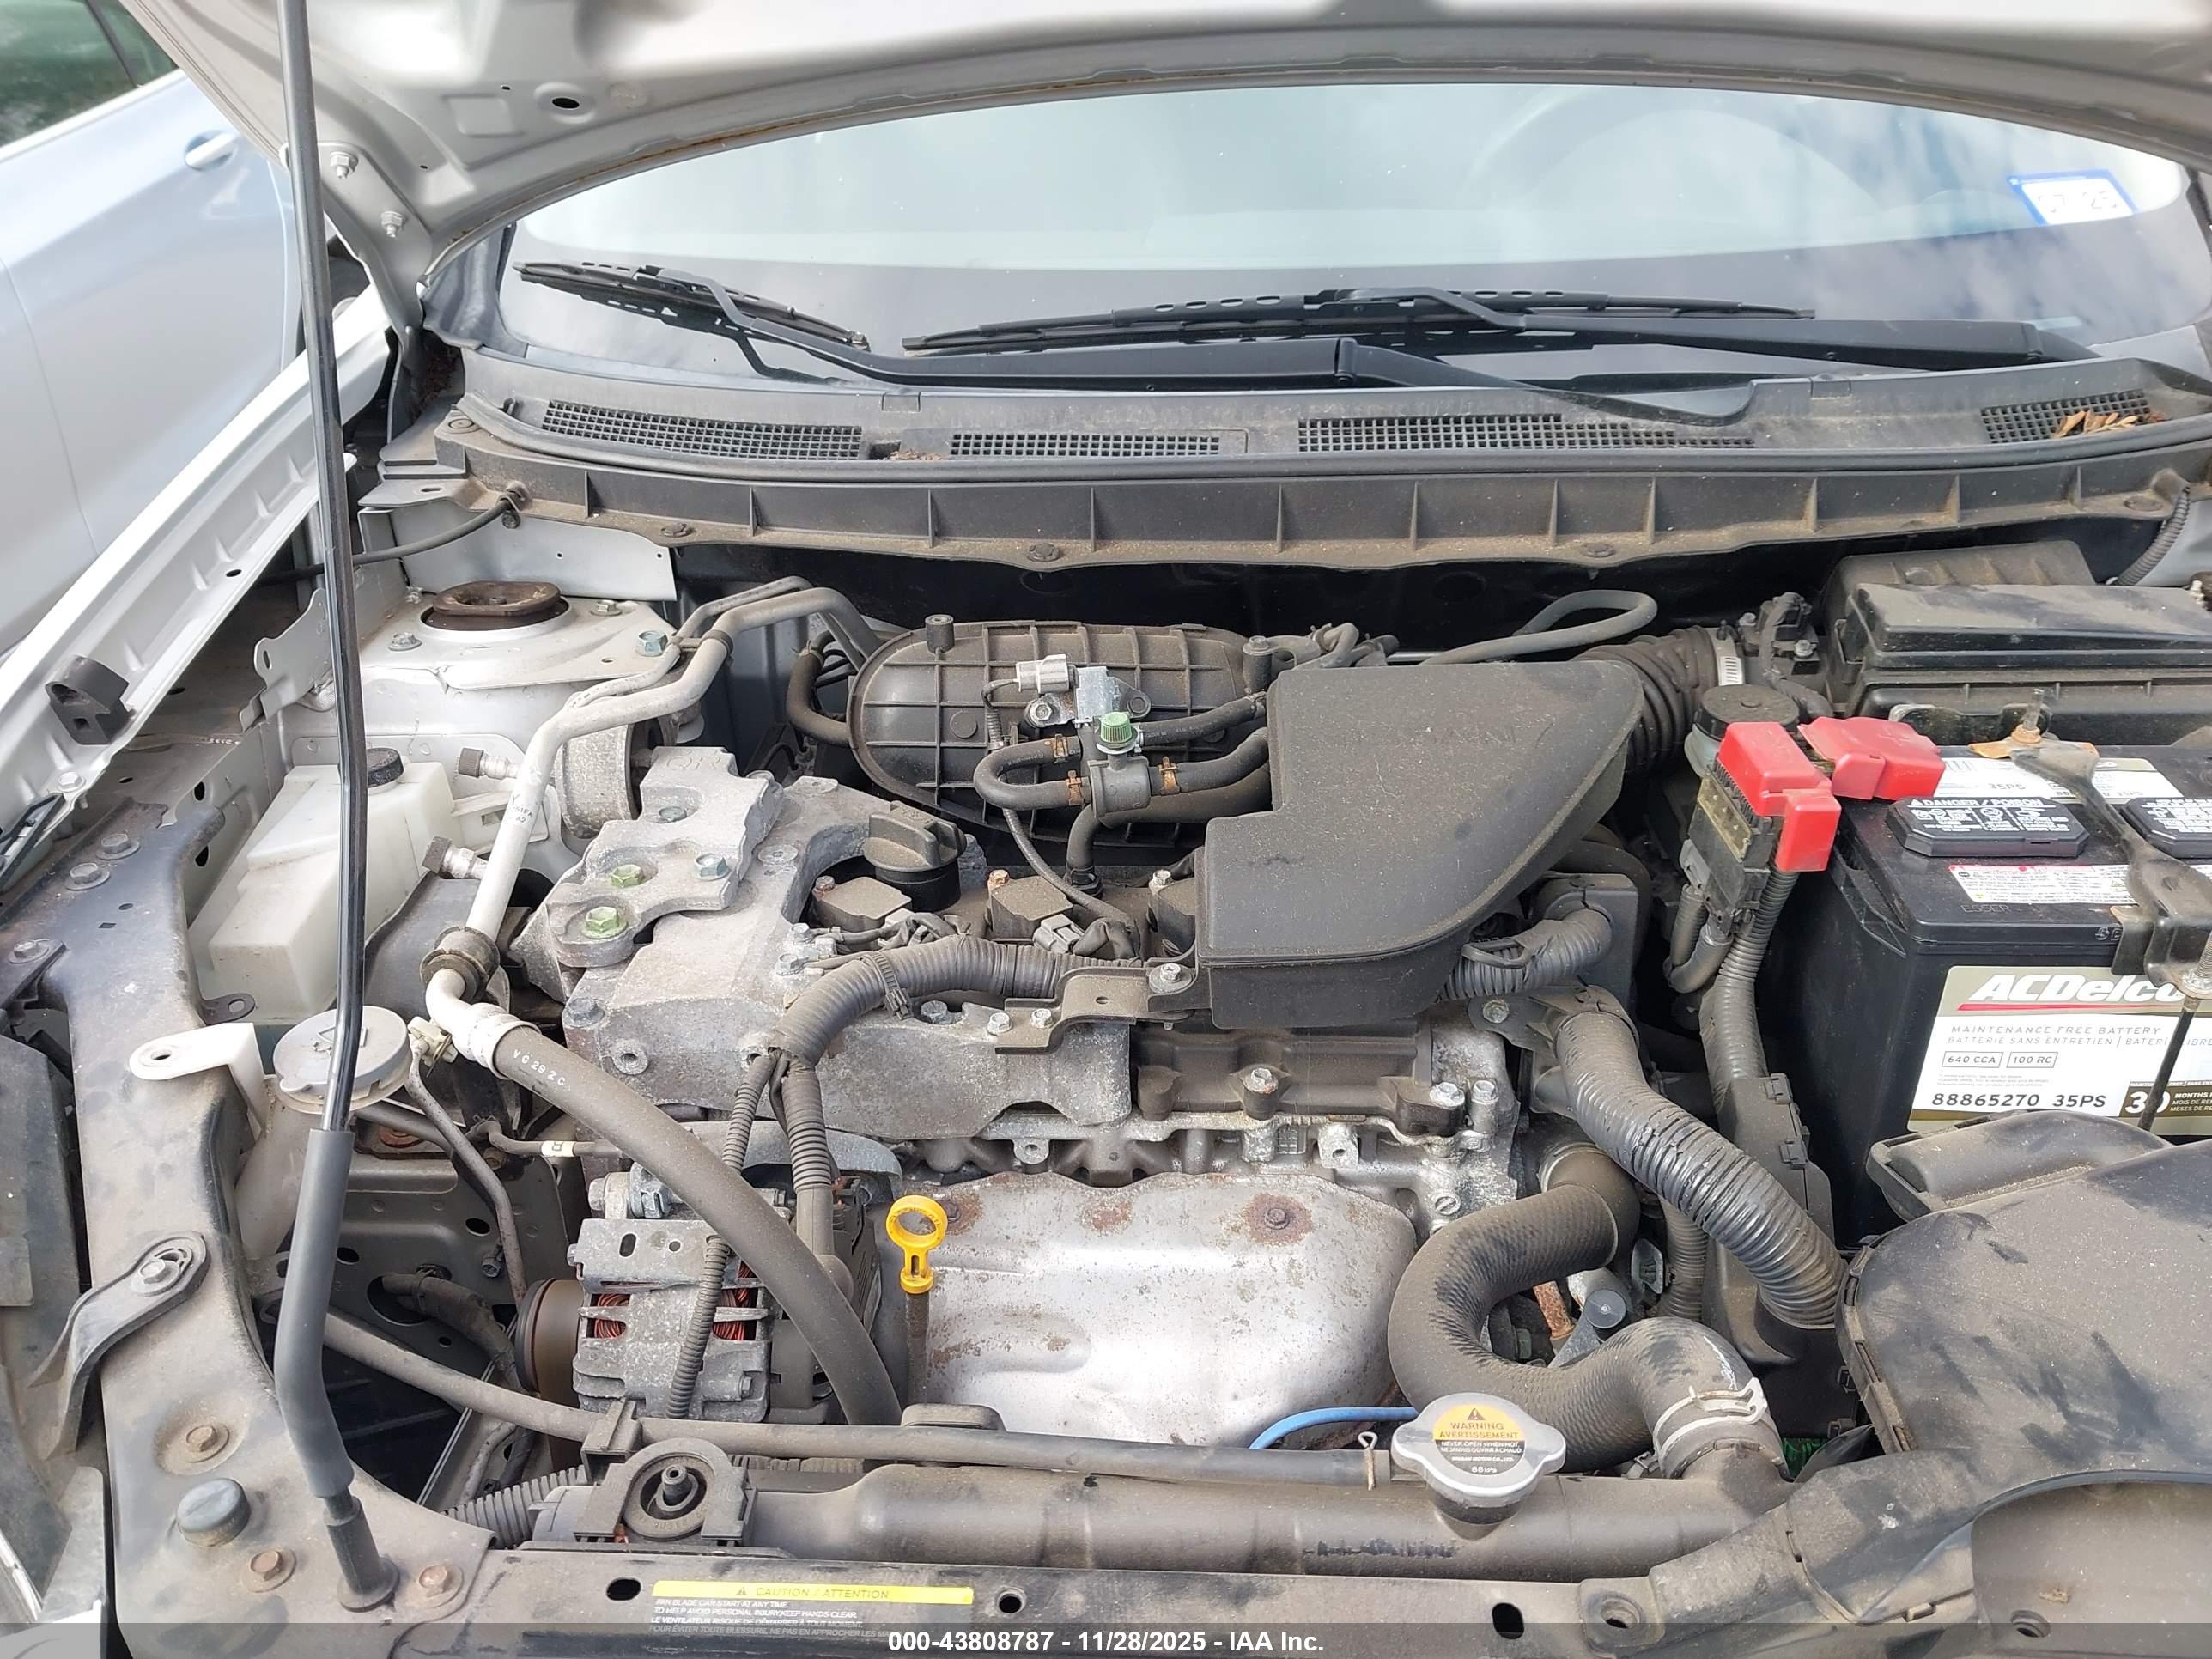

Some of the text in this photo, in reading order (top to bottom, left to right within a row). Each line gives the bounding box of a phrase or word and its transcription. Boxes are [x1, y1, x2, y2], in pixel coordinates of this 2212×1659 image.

[1951, 1026, 2161, 1036] MAINTENANCE FREE BATTERY
[1948, 1036, 2005, 1045] BATTERIE
[2044, 1037, 2112, 1046] ENTRETIEN
[1948, 1055, 1996, 1064] 640 CCA
[1932, 1093, 2107, 1108] 88865270 35PS
[1450, 1422, 1504, 1431] WARNING
[1439, 1431, 1519, 1439] AVERTISSEMENT
[756, 1587, 810, 1597] CAUTION
[823, 1589, 890, 1599] ATTENTION
[661, 1616, 711, 1625] VENTILATEUR
[672, 1624, 700, 1633] ÉVITER
[700, 1626, 726, 1634] TOUTE
[782, 1627, 798, 1636] PAS
